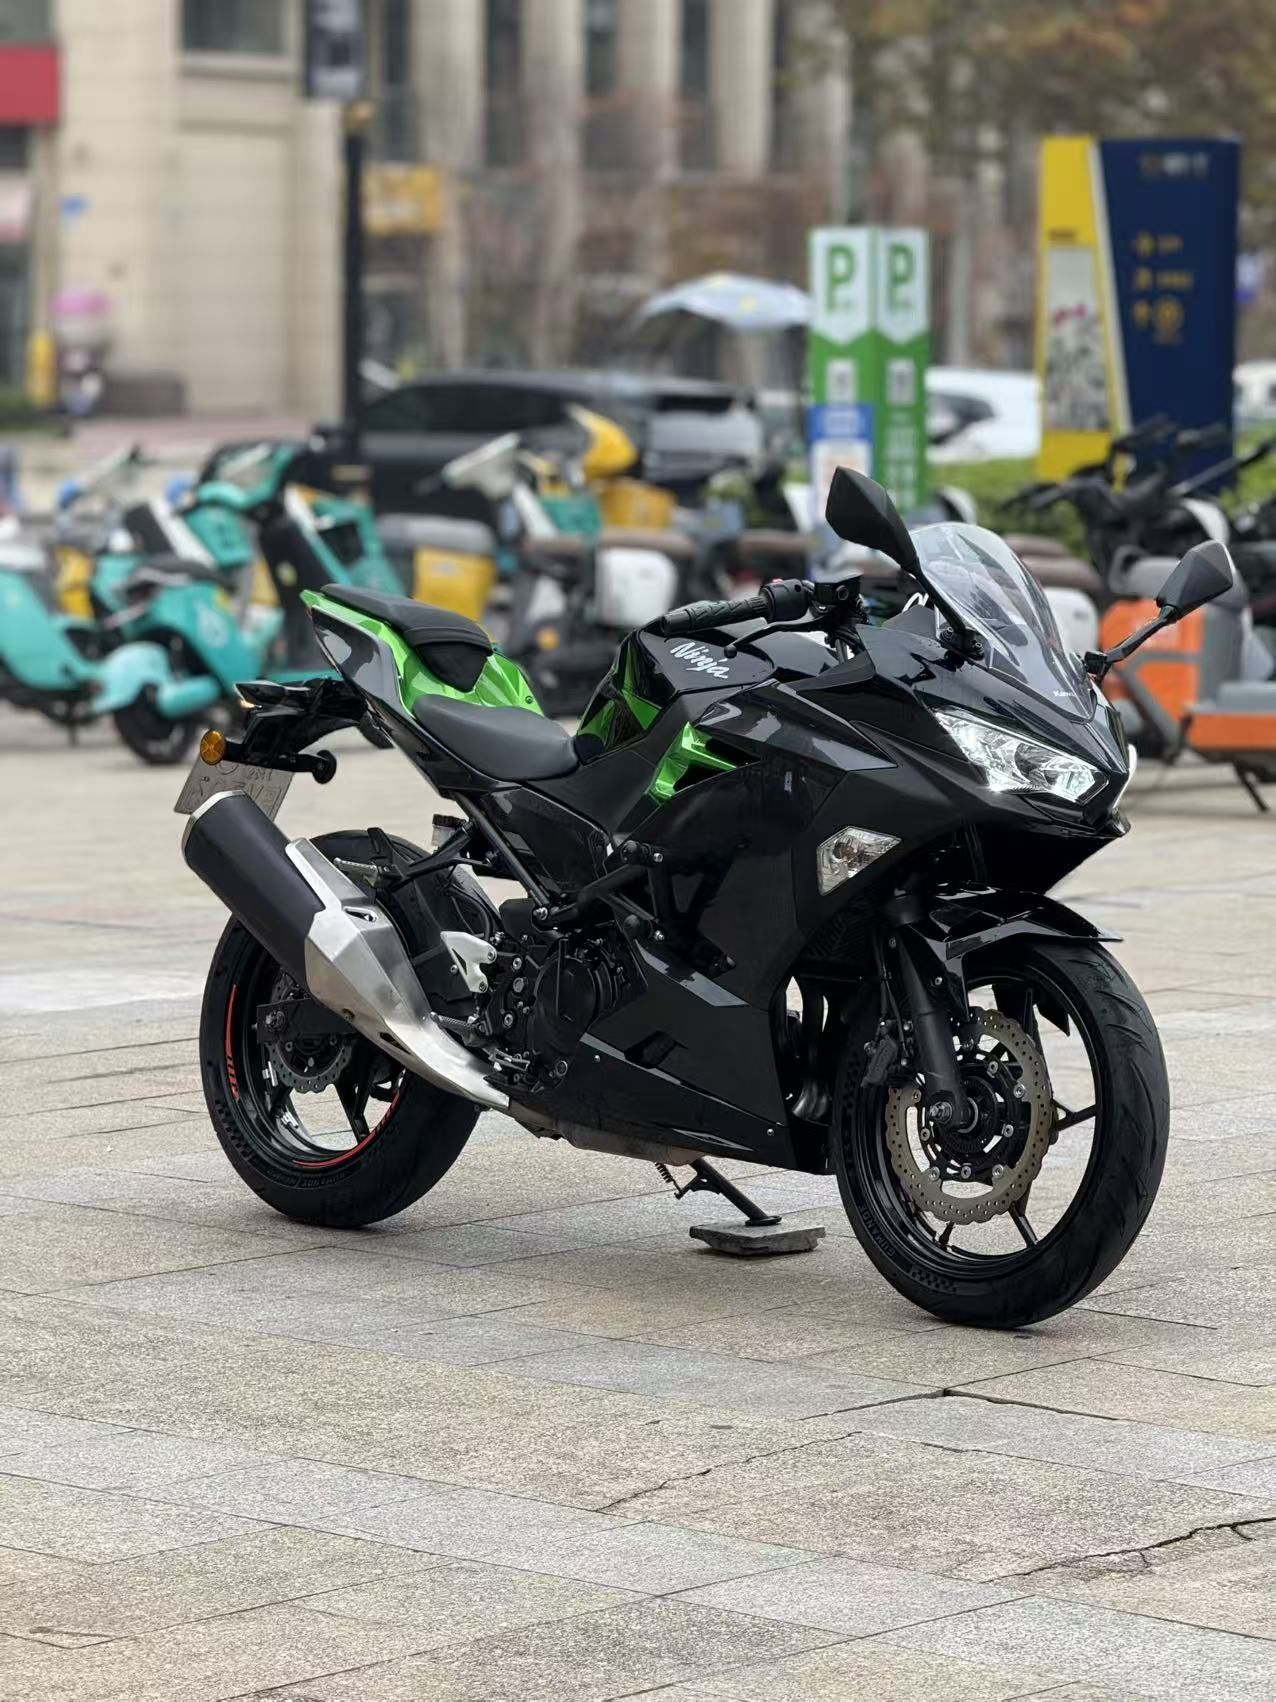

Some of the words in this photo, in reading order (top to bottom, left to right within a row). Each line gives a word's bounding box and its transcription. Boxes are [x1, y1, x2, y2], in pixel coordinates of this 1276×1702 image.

[827, 243, 855, 316] P
[888, 243, 914, 312] P
[669, 642, 730, 679] Ninja
